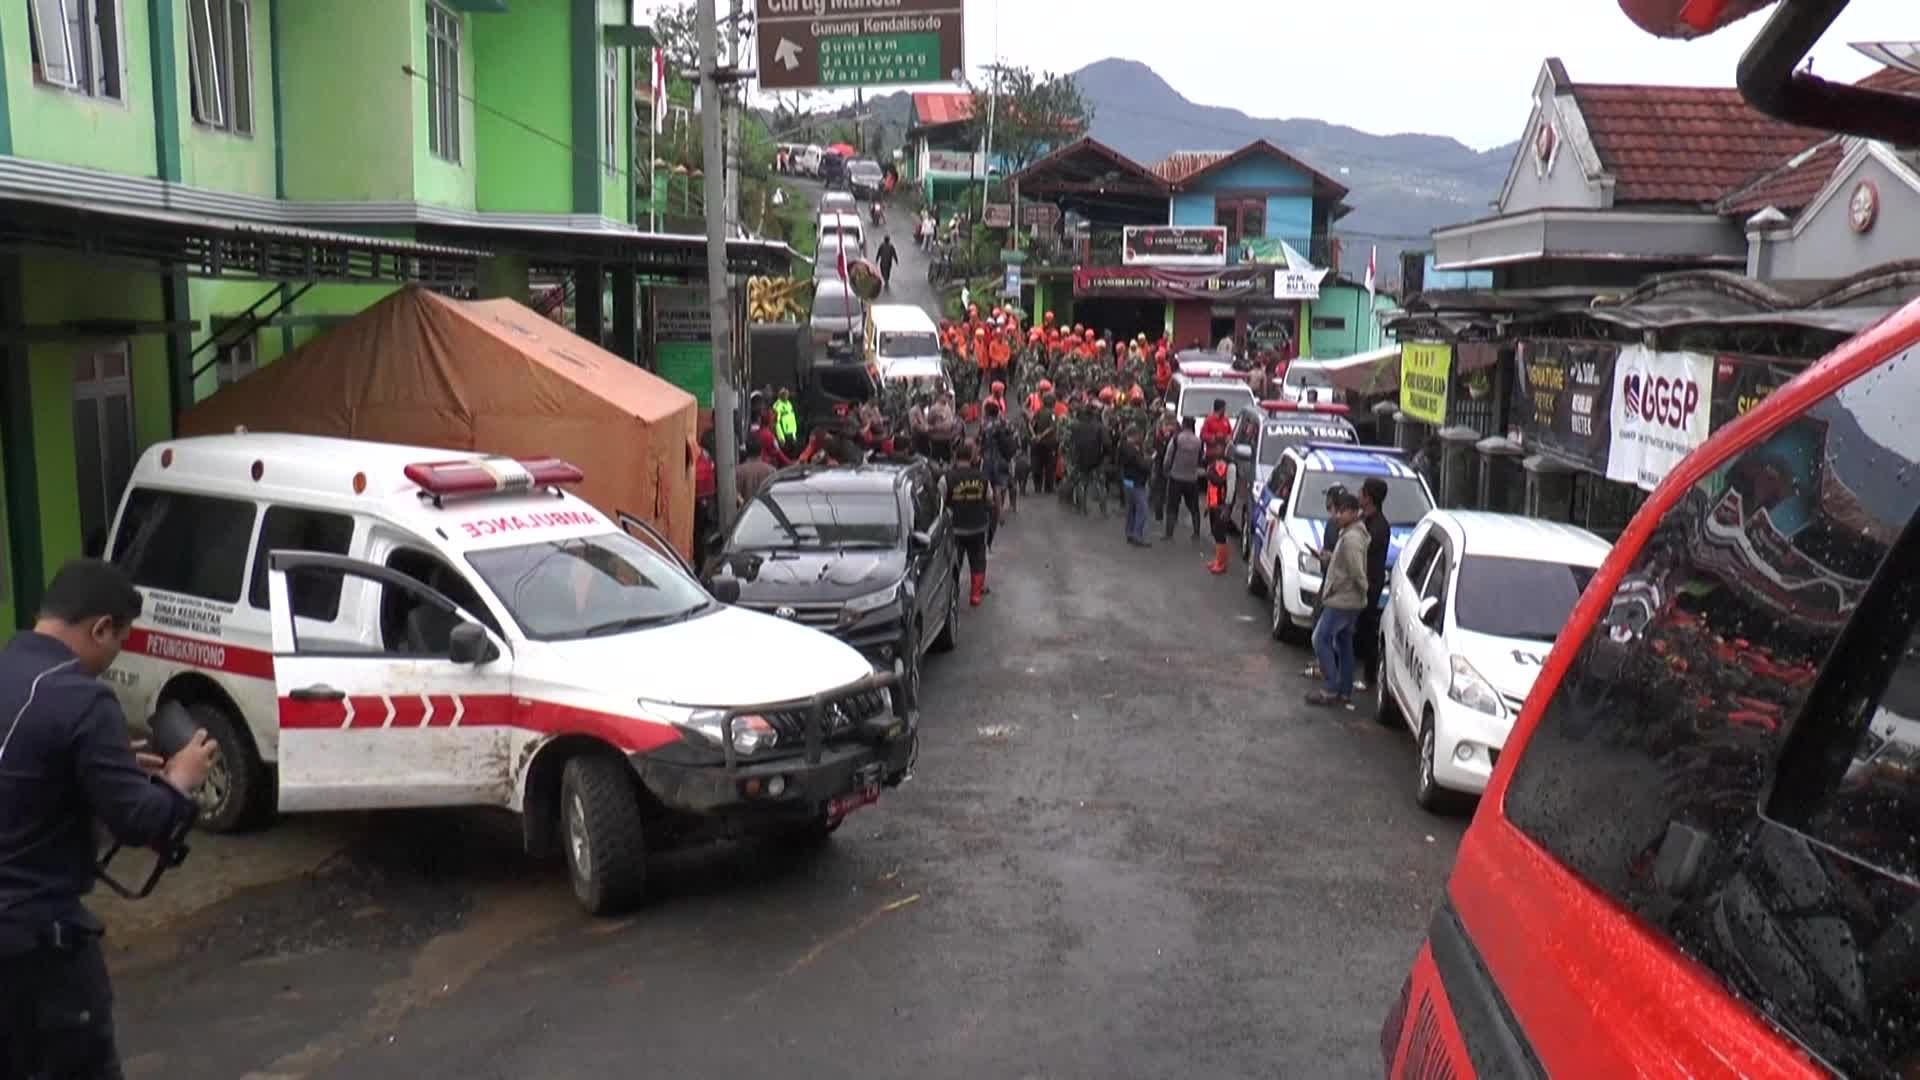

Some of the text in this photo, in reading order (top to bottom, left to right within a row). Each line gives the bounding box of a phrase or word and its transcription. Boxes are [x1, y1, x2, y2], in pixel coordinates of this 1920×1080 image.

[811, 16, 941, 37] Gunung Kendalisodo
[821, 39, 897, 53] Gumelem
[823, 68, 918, 82] Wanayasa
[1641, 372, 1699, 432] GGSP
[1267, 425, 1353, 440] LANAL TEGAL
[178, 606, 221, 624] KESEHATAN
